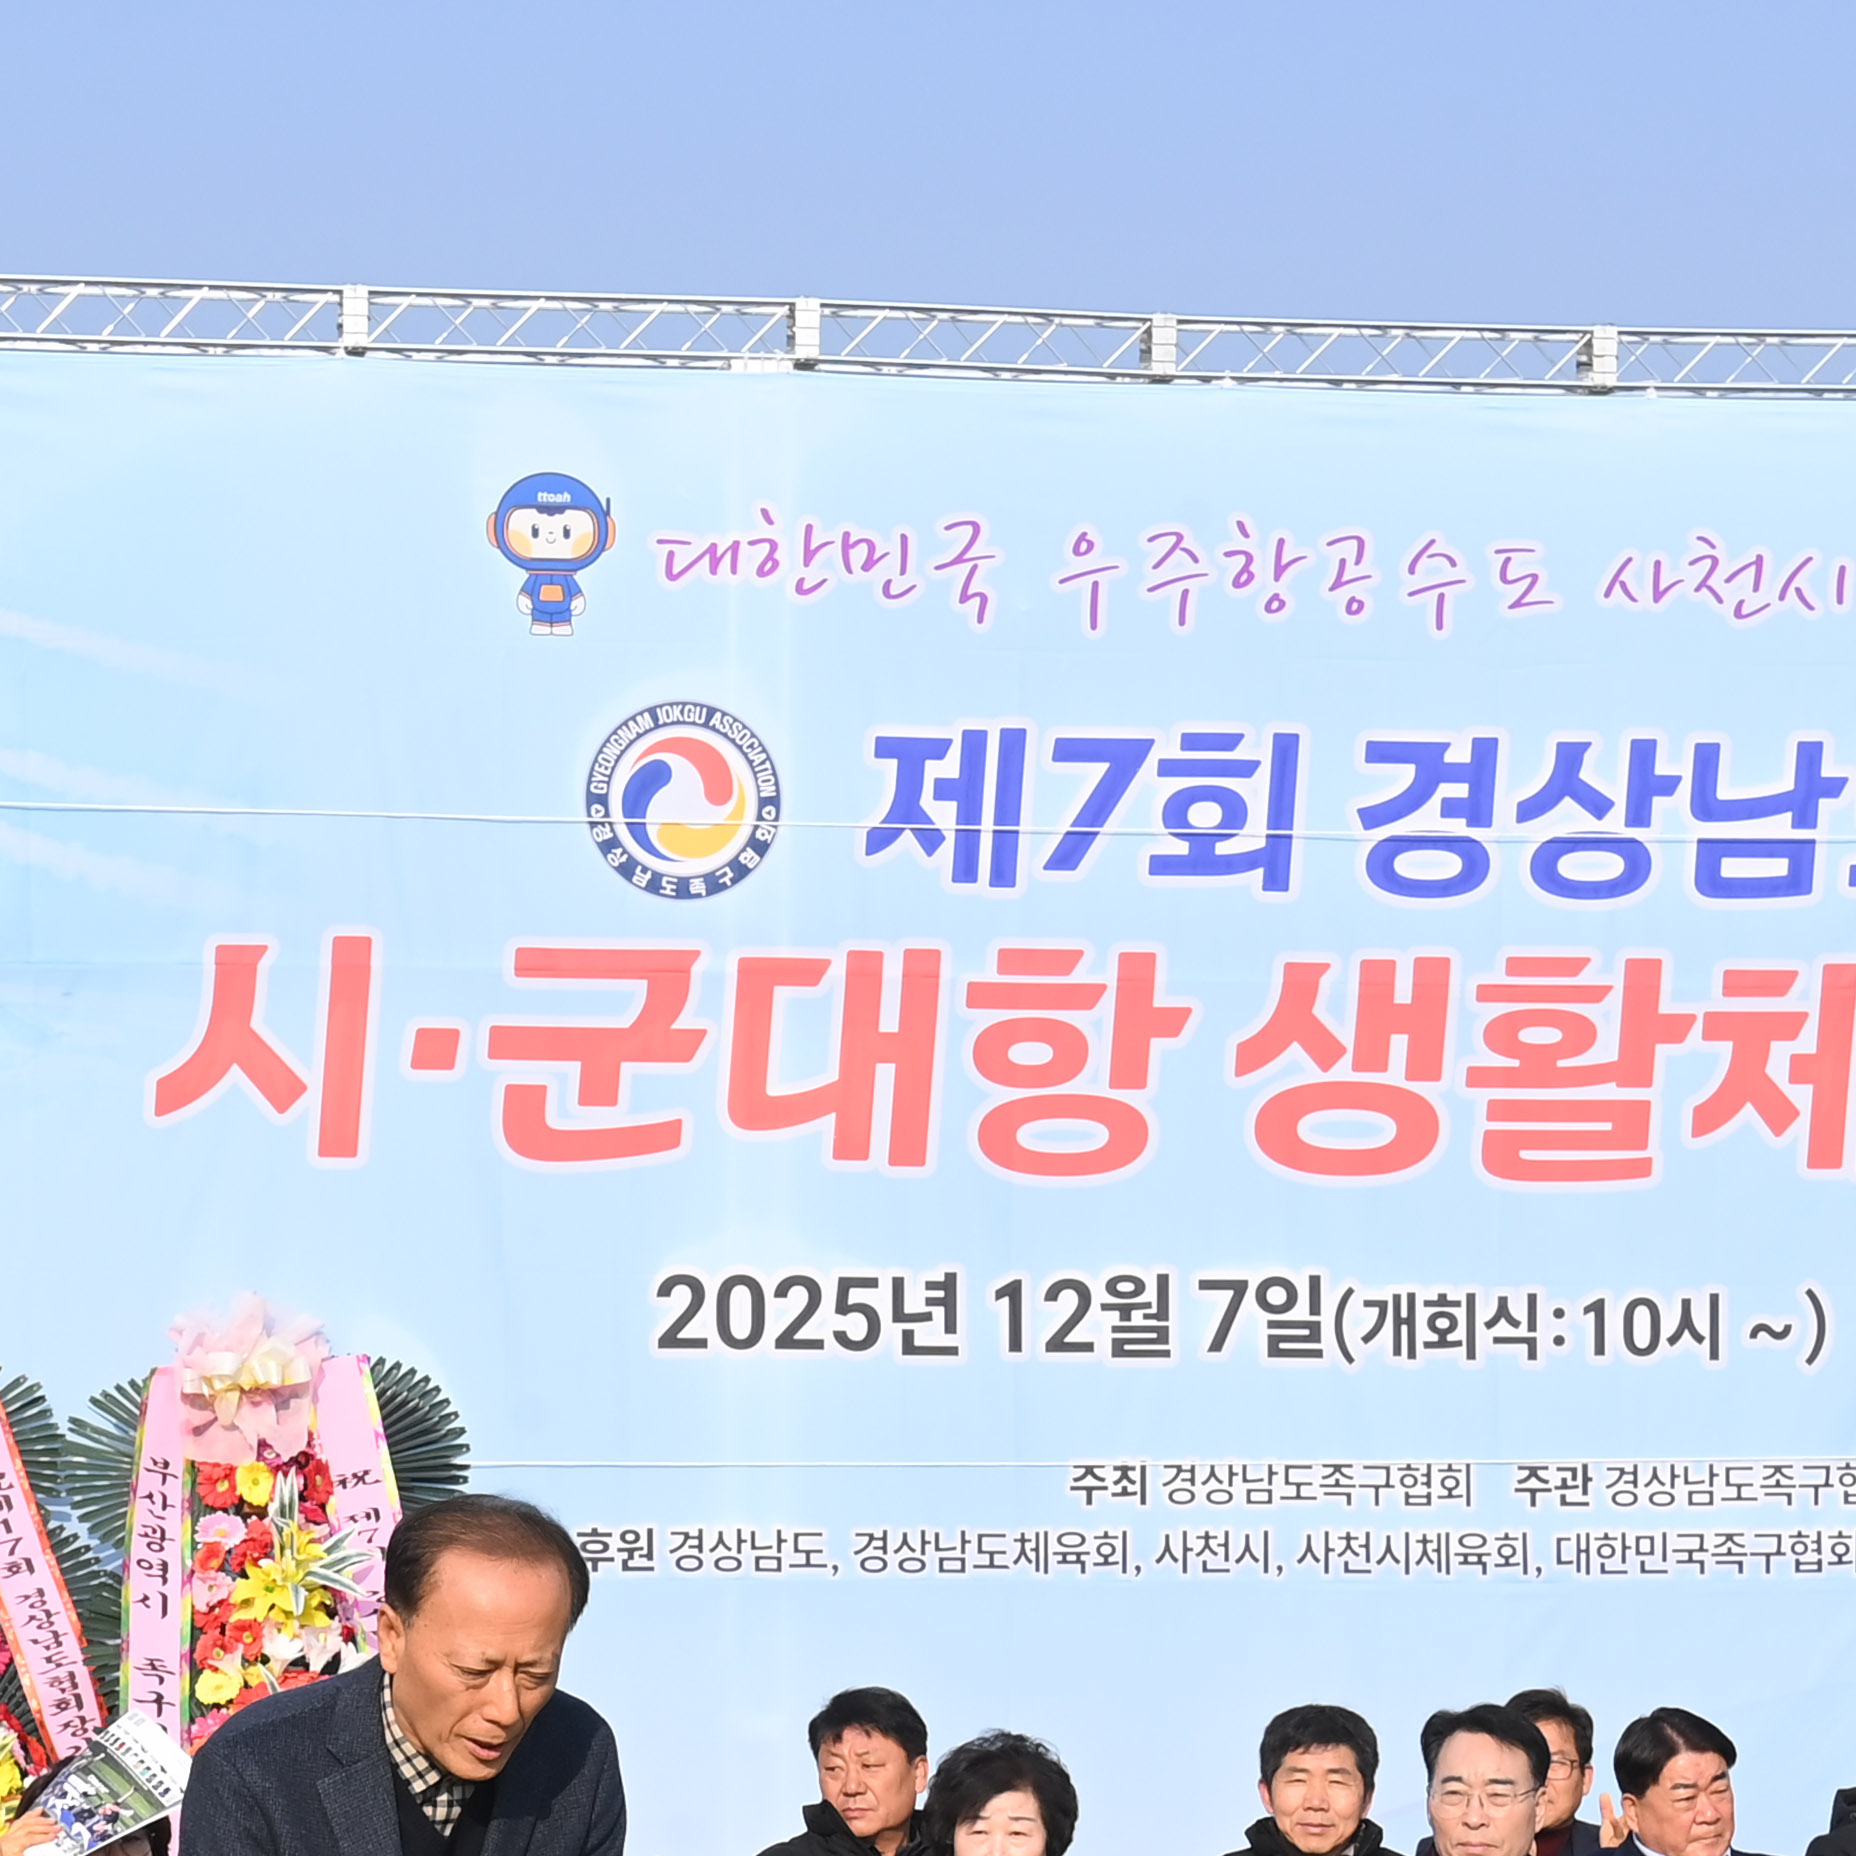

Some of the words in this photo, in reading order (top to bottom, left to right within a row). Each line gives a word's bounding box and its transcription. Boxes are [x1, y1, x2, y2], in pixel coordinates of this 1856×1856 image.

[537, 491, 572, 503] ttoah
[658, 507, 996, 625] 대한민국
[1055, 520, 1552, 631] 우주항공수도
[1601, 536, 1848, 620] 사천시
[590, 711, 656, 795] GYEONGNAM
[655, 704, 708, 726] JOKGU
[709, 711, 778, 798] ASSOCIATION
[865, 727, 1300, 892] 제7회
[152, 934, 1194, 1178] 시·군대항
[656, 1272, 960, 1356] 2025년
[994, 1273, 1173, 1358] 12월
[334, 1467, 381, 1491] 祝
[1069, 1464, 1147, 1505] 주최
[1163, 1463, 1472, 1507] 경상남도족구협회
[1515, 1463, 1594, 1507] 주관
[131, 1455, 179, 1620] 부산광역시
[343, 1506, 387, 1562] 제7
[577, 1528, 655, 1572] 후원
[669, 1528, 839, 1577] 경상남도,
[853, 1530, 1142, 1576] 경상남도체육회,
[1155, 1530, 1284, 1577] 사천시,
[1297, 1531, 1544, 1578] 사천시체육회,
[132, 1655, 177, 1732] 족구
